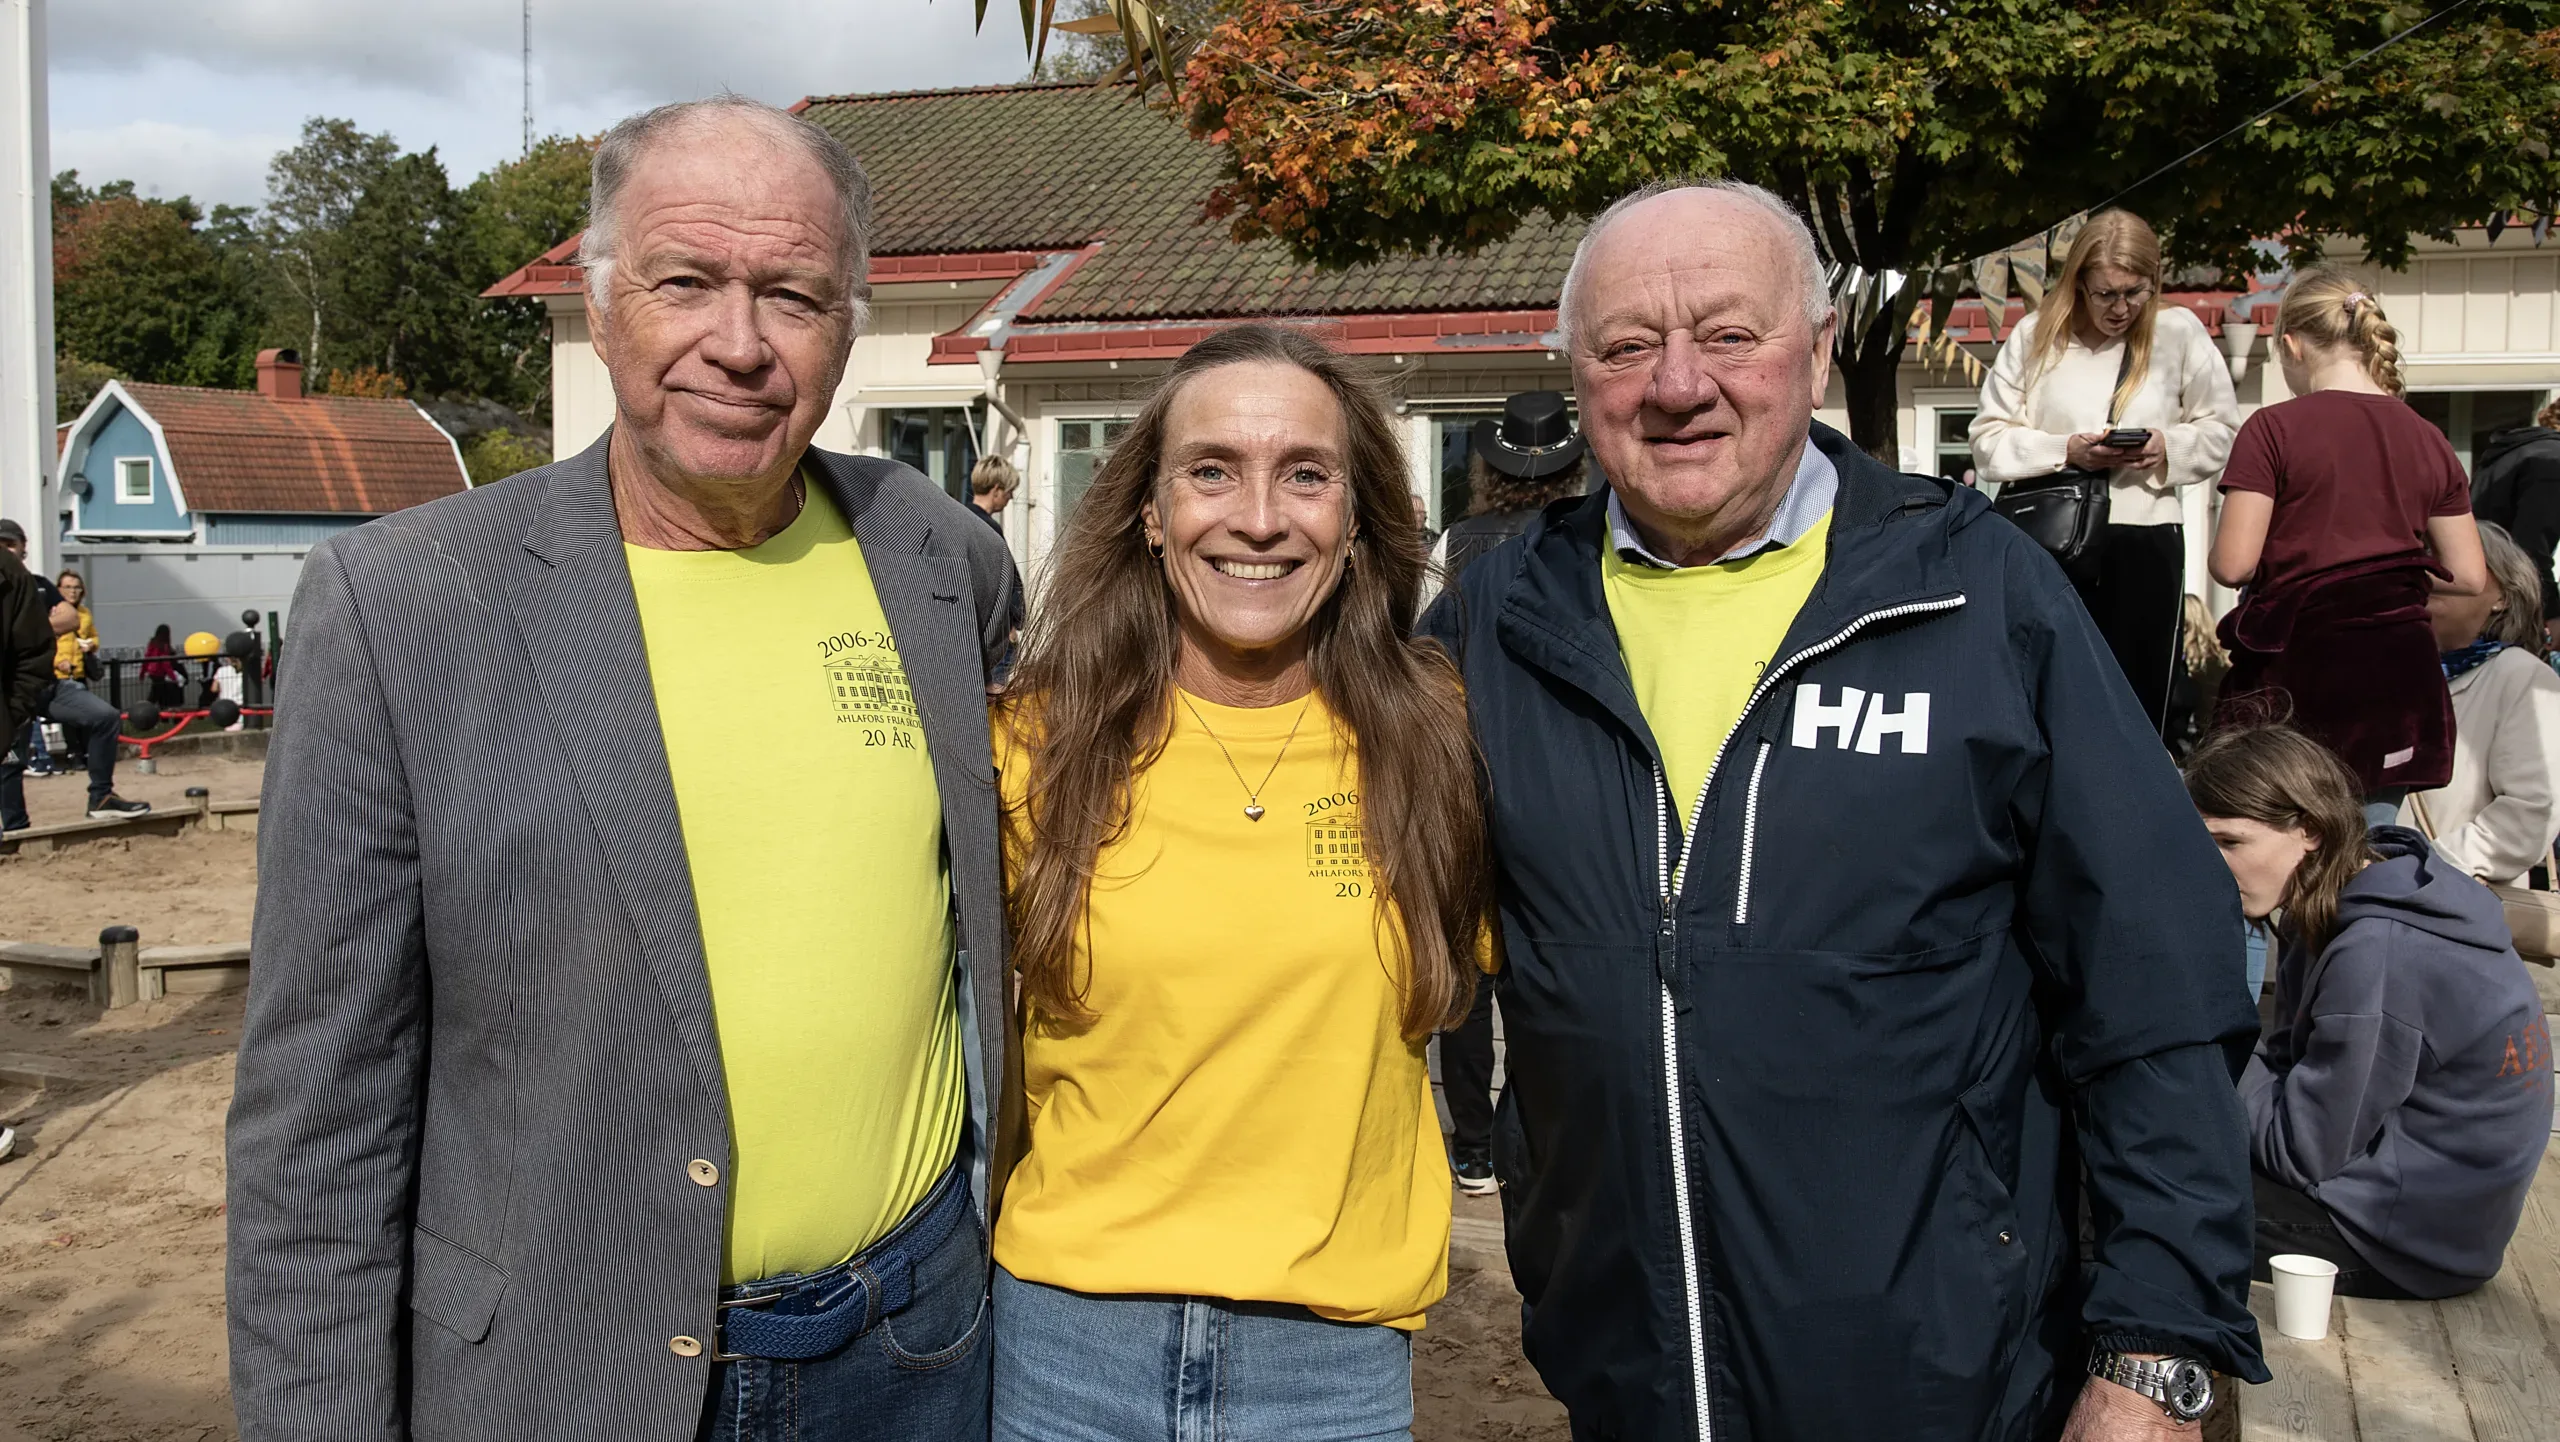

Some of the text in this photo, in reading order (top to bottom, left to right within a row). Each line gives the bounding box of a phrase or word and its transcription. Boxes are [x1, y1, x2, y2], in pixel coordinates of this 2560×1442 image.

[817, 630, 897, 659] 2006-20
[836, 714, 924, 729] AHLAFORS FRIA SKOL
[1791, 683, 1931, 755] HH
[862, 727, 916, 749] 20 ÅR
[1303, 789, 1360, 817] 2006
[1308, 869, 1364, 878] AHLAFORS
[1335, 882, 1361, 898] 20
